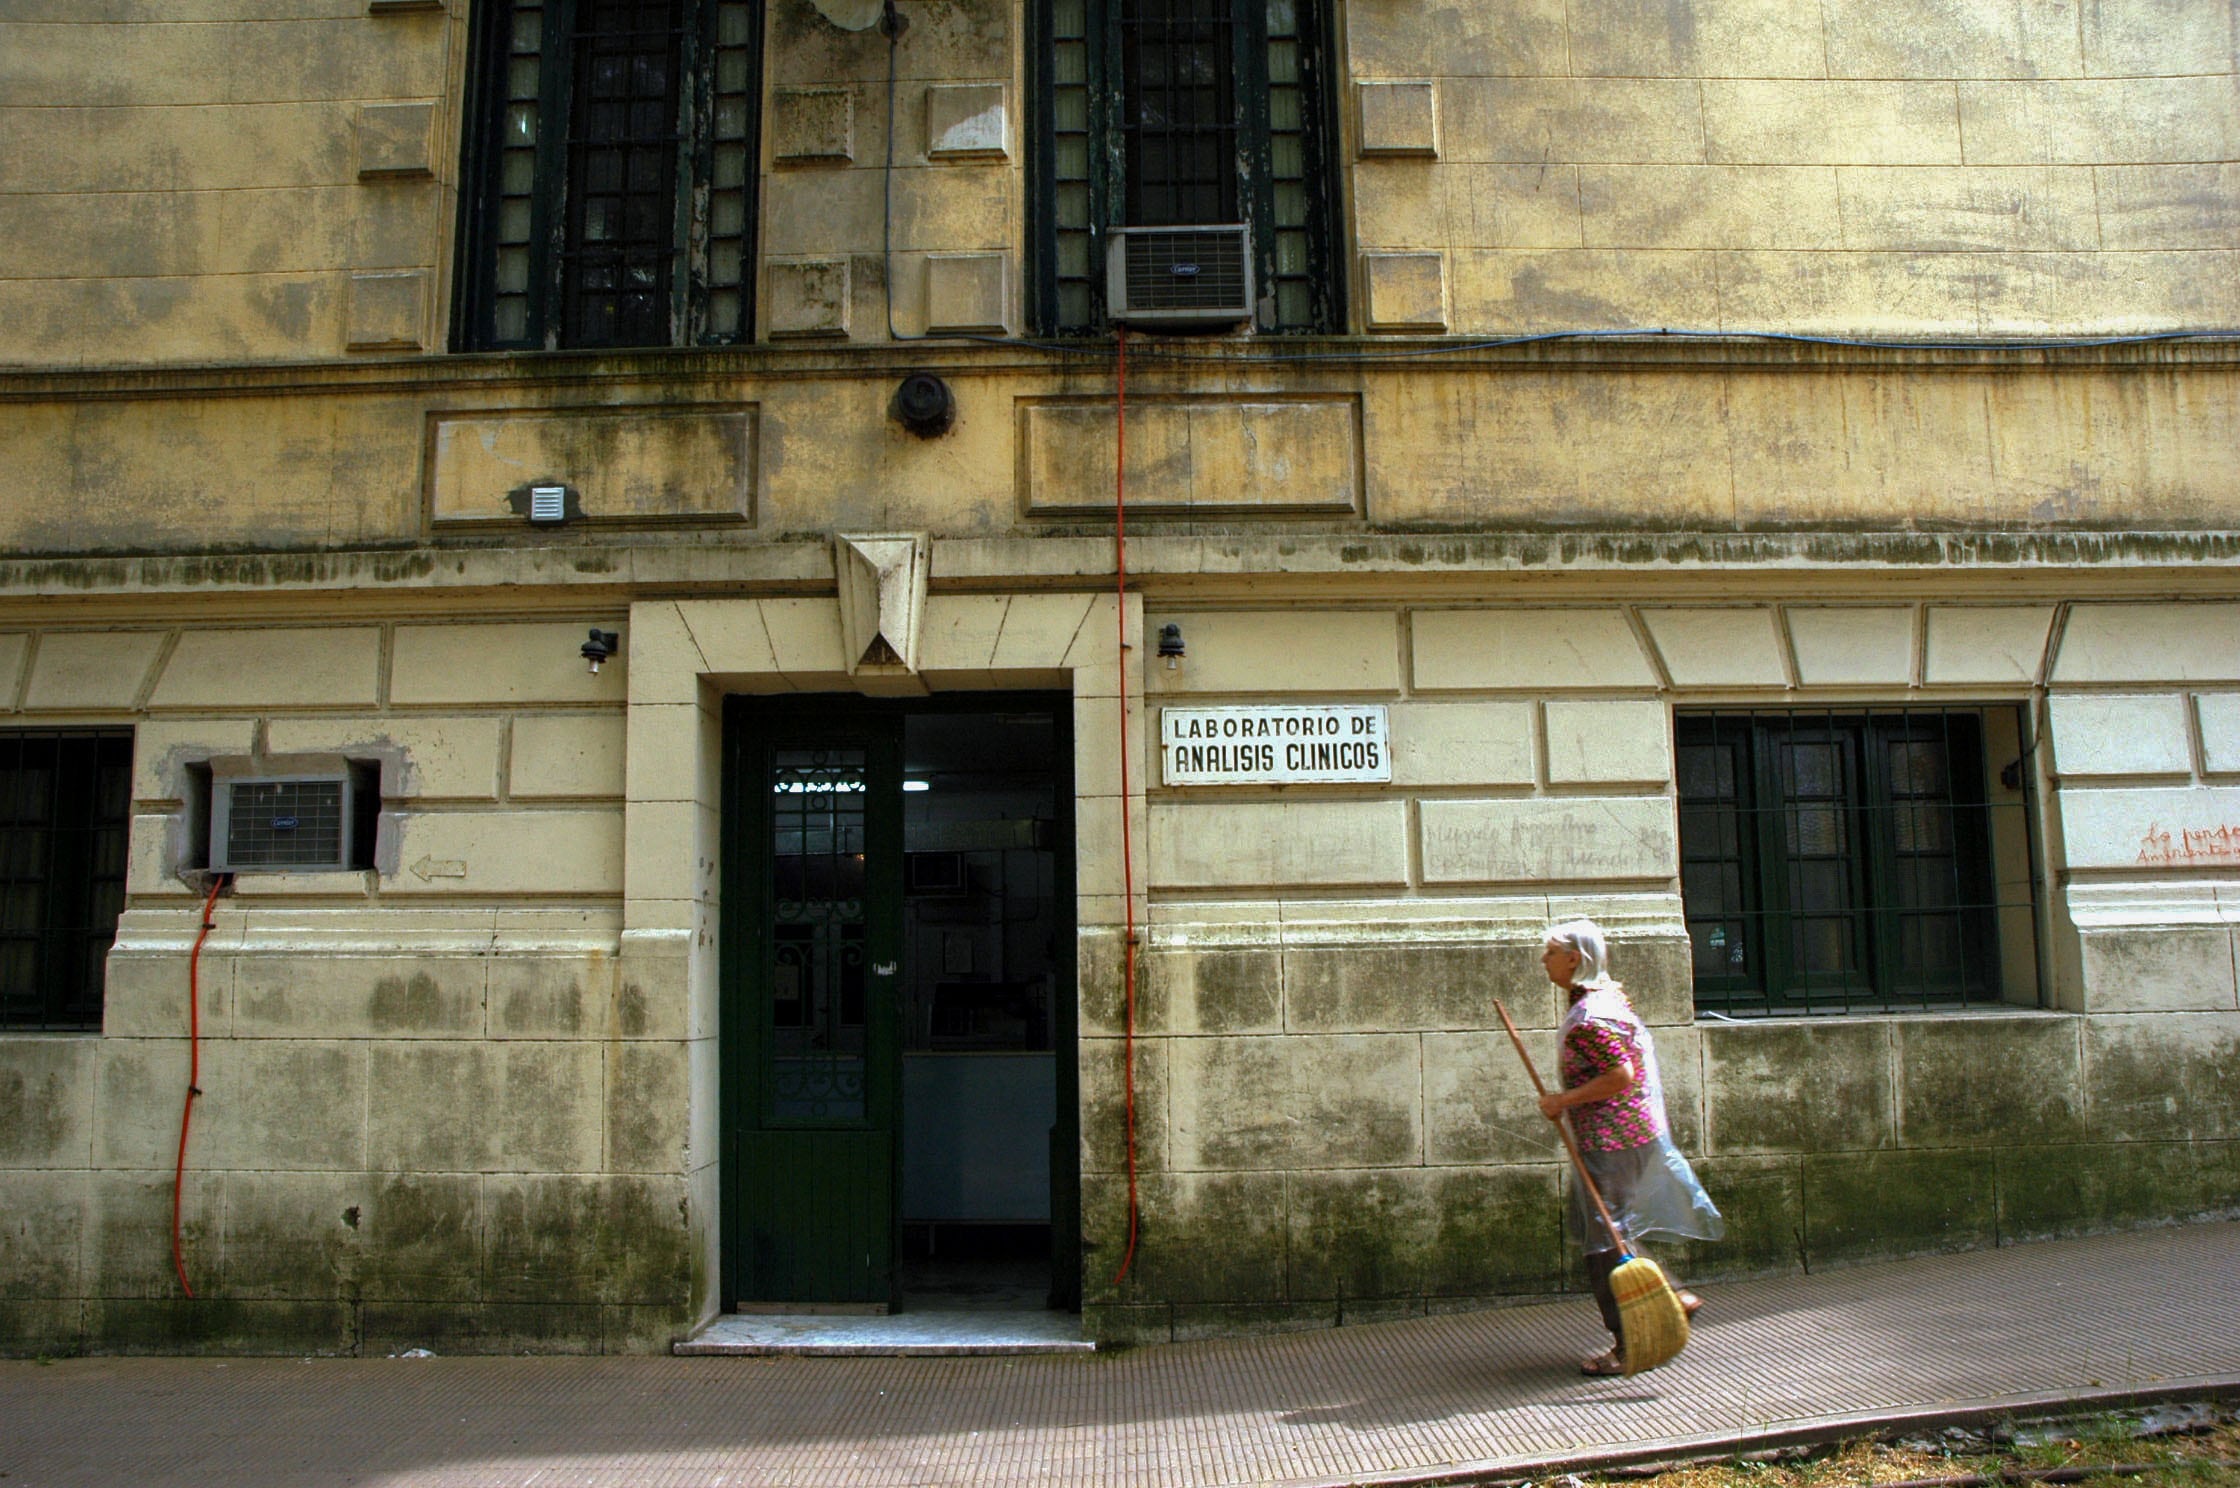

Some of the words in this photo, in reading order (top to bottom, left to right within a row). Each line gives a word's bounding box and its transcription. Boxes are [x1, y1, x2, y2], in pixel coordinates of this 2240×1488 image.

[1174, 717, 1339, 738] LABORATORIO
[1352, 716, 1377, 735] DE
[1175, 744, 1274, 773] ANALISIS
[1285, 742, 1379, 771] CLINICOS
